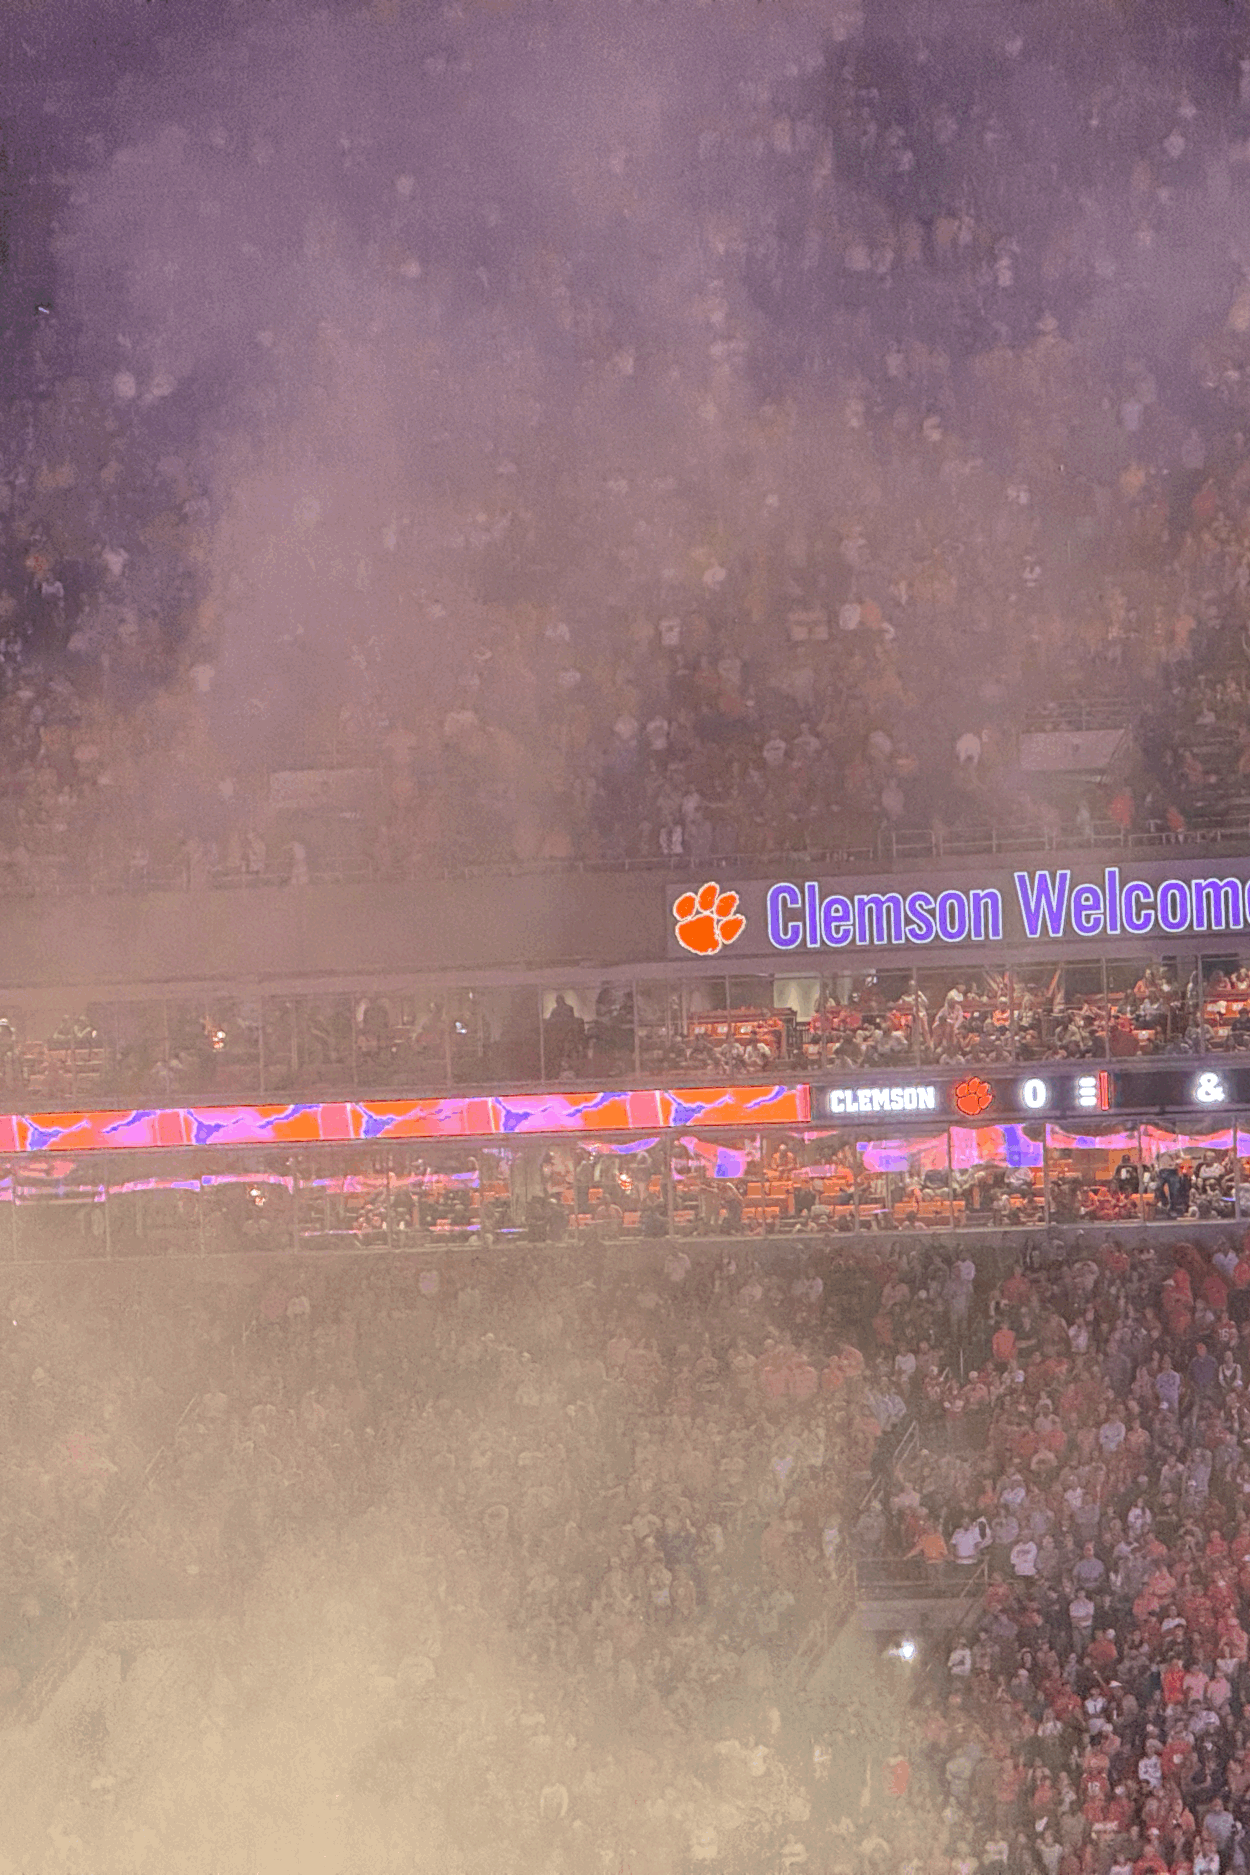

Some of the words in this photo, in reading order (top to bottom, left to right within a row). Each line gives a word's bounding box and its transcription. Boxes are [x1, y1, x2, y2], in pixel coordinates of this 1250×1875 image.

[767, 881, 1003, 949] Clemson
[829, 1086, 936, 1113] CLEMSON
[1022, 1078, 1047, 1109] 0
[1195, 1072, 1225, 1103] &
